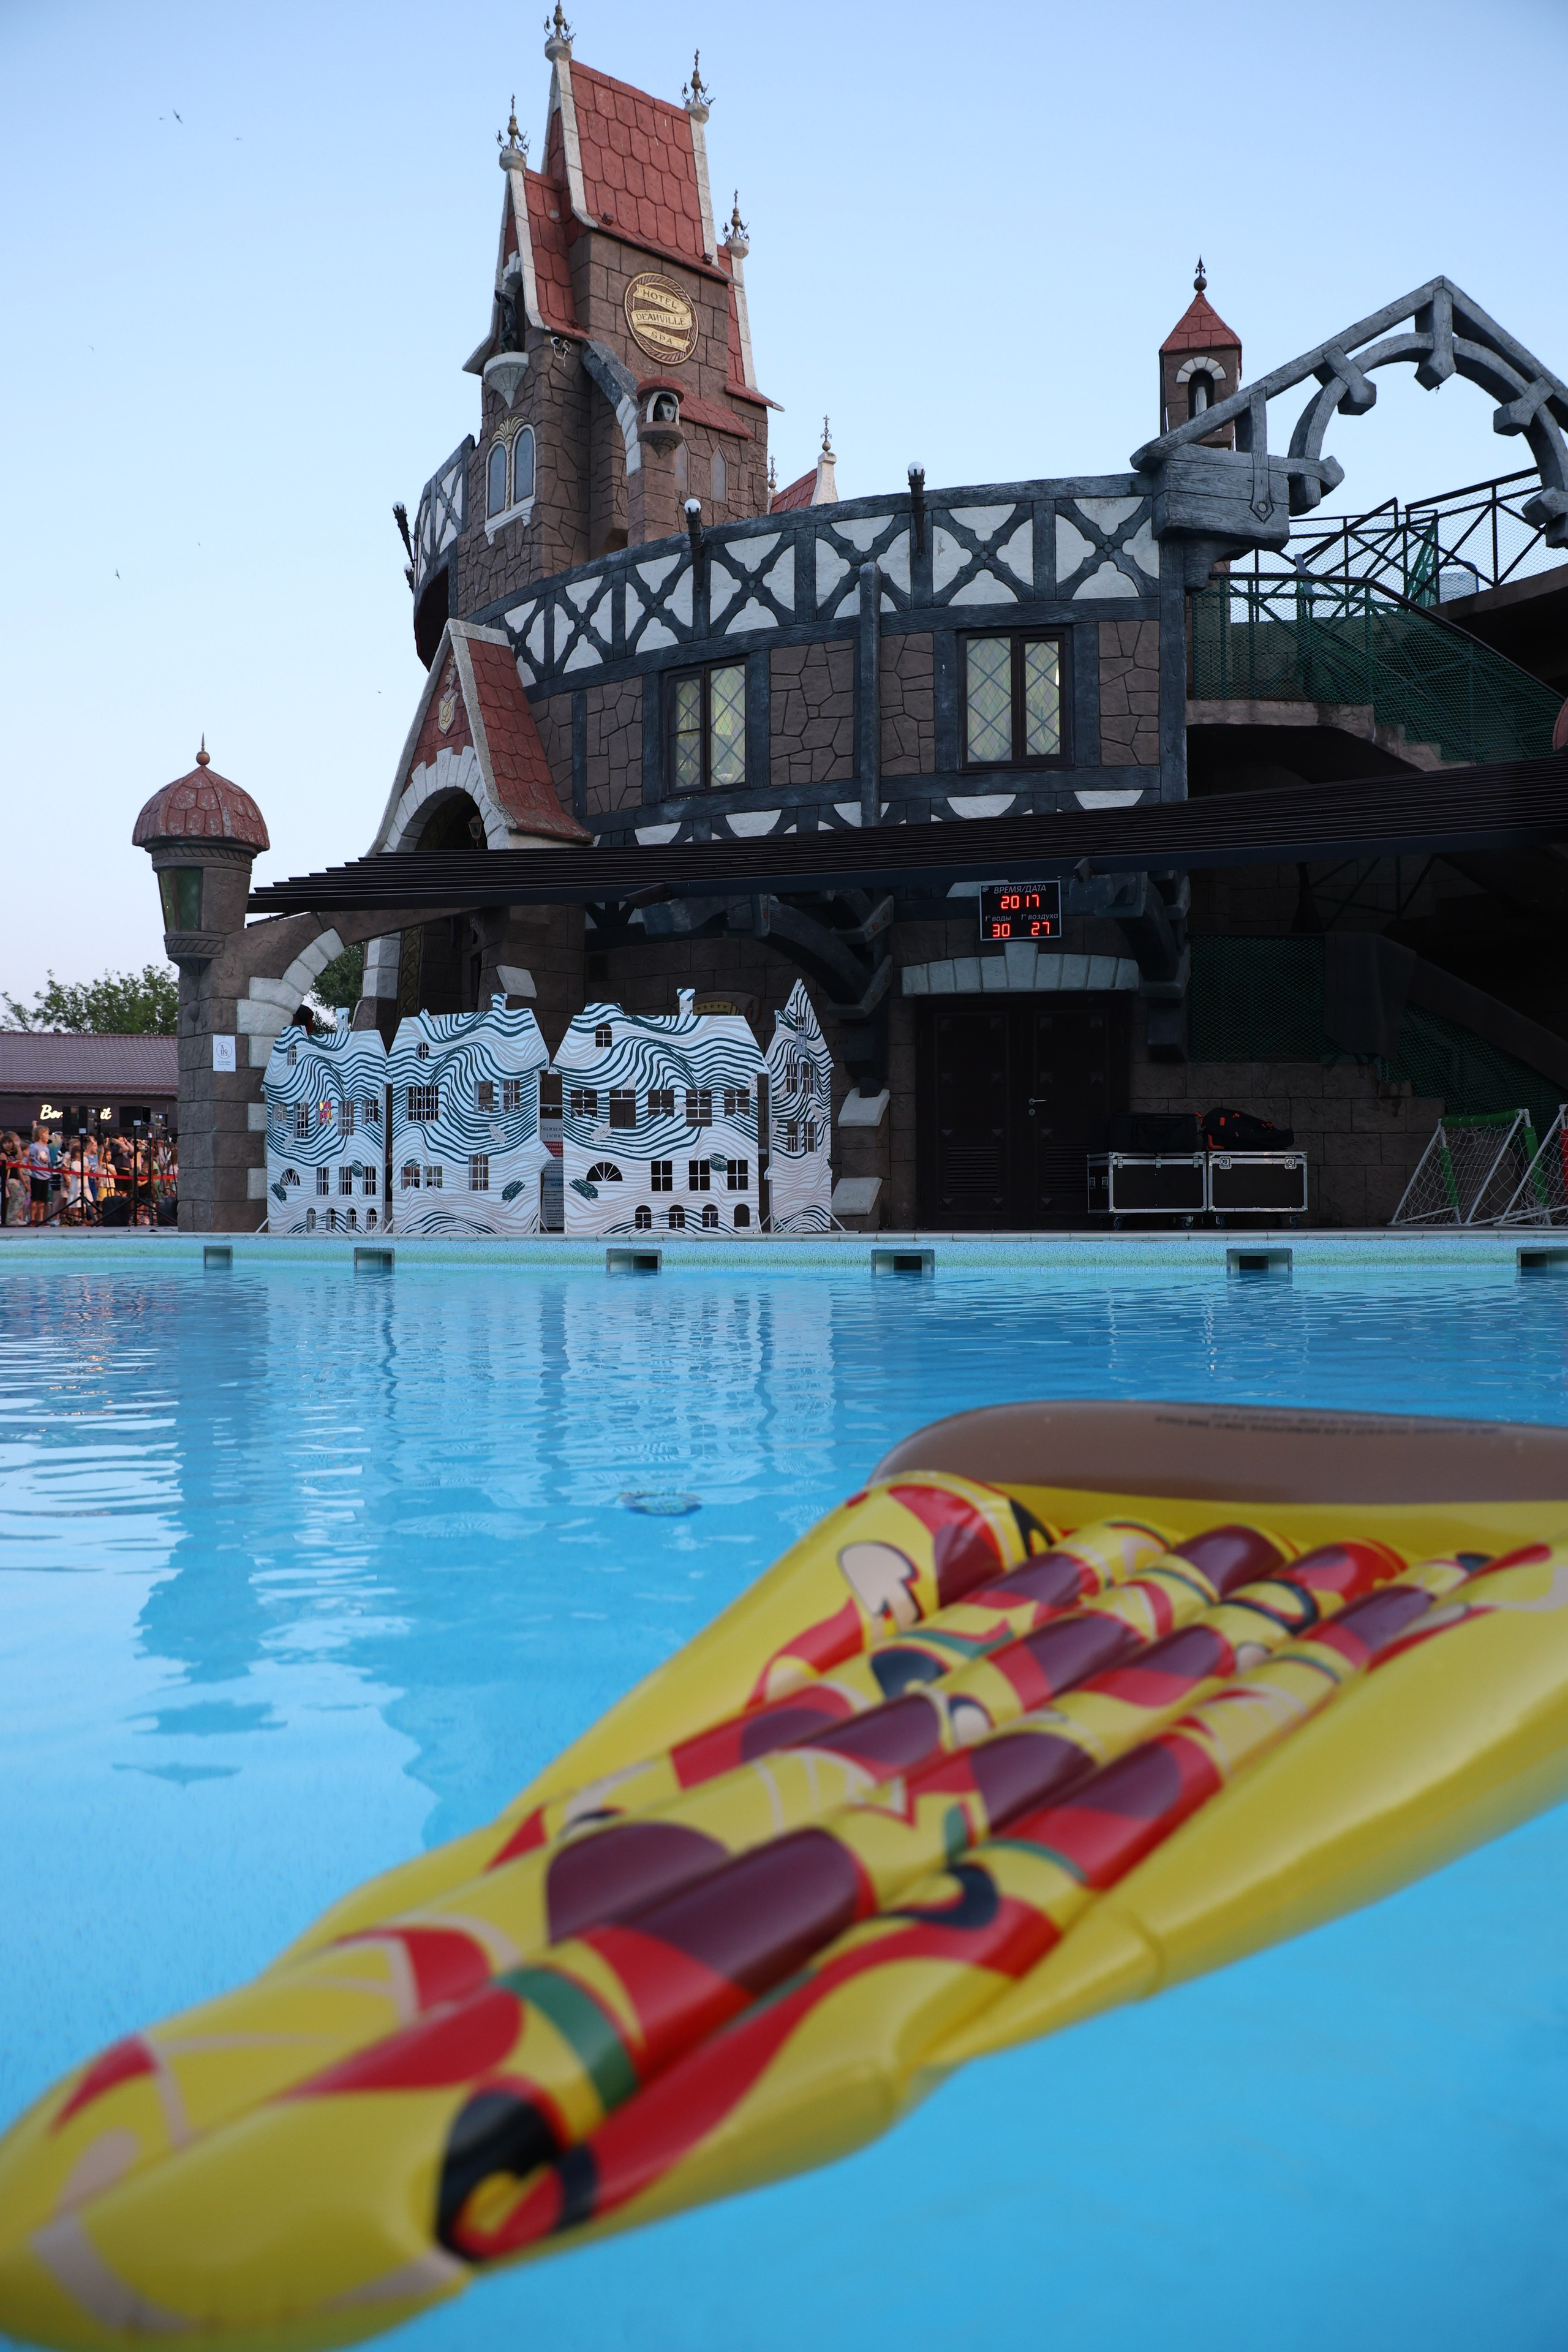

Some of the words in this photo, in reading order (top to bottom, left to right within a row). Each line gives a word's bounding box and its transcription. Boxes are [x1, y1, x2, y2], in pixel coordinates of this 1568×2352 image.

[643, 289, 677, 309] HOTEL
[650, 331, 673, 345] SPA
[993, 884, 1046, 894] ВРЕМЯ/ДАТА
[992, 924, 1010, 937] 30
[1031, 922, 1050, 935] 27
